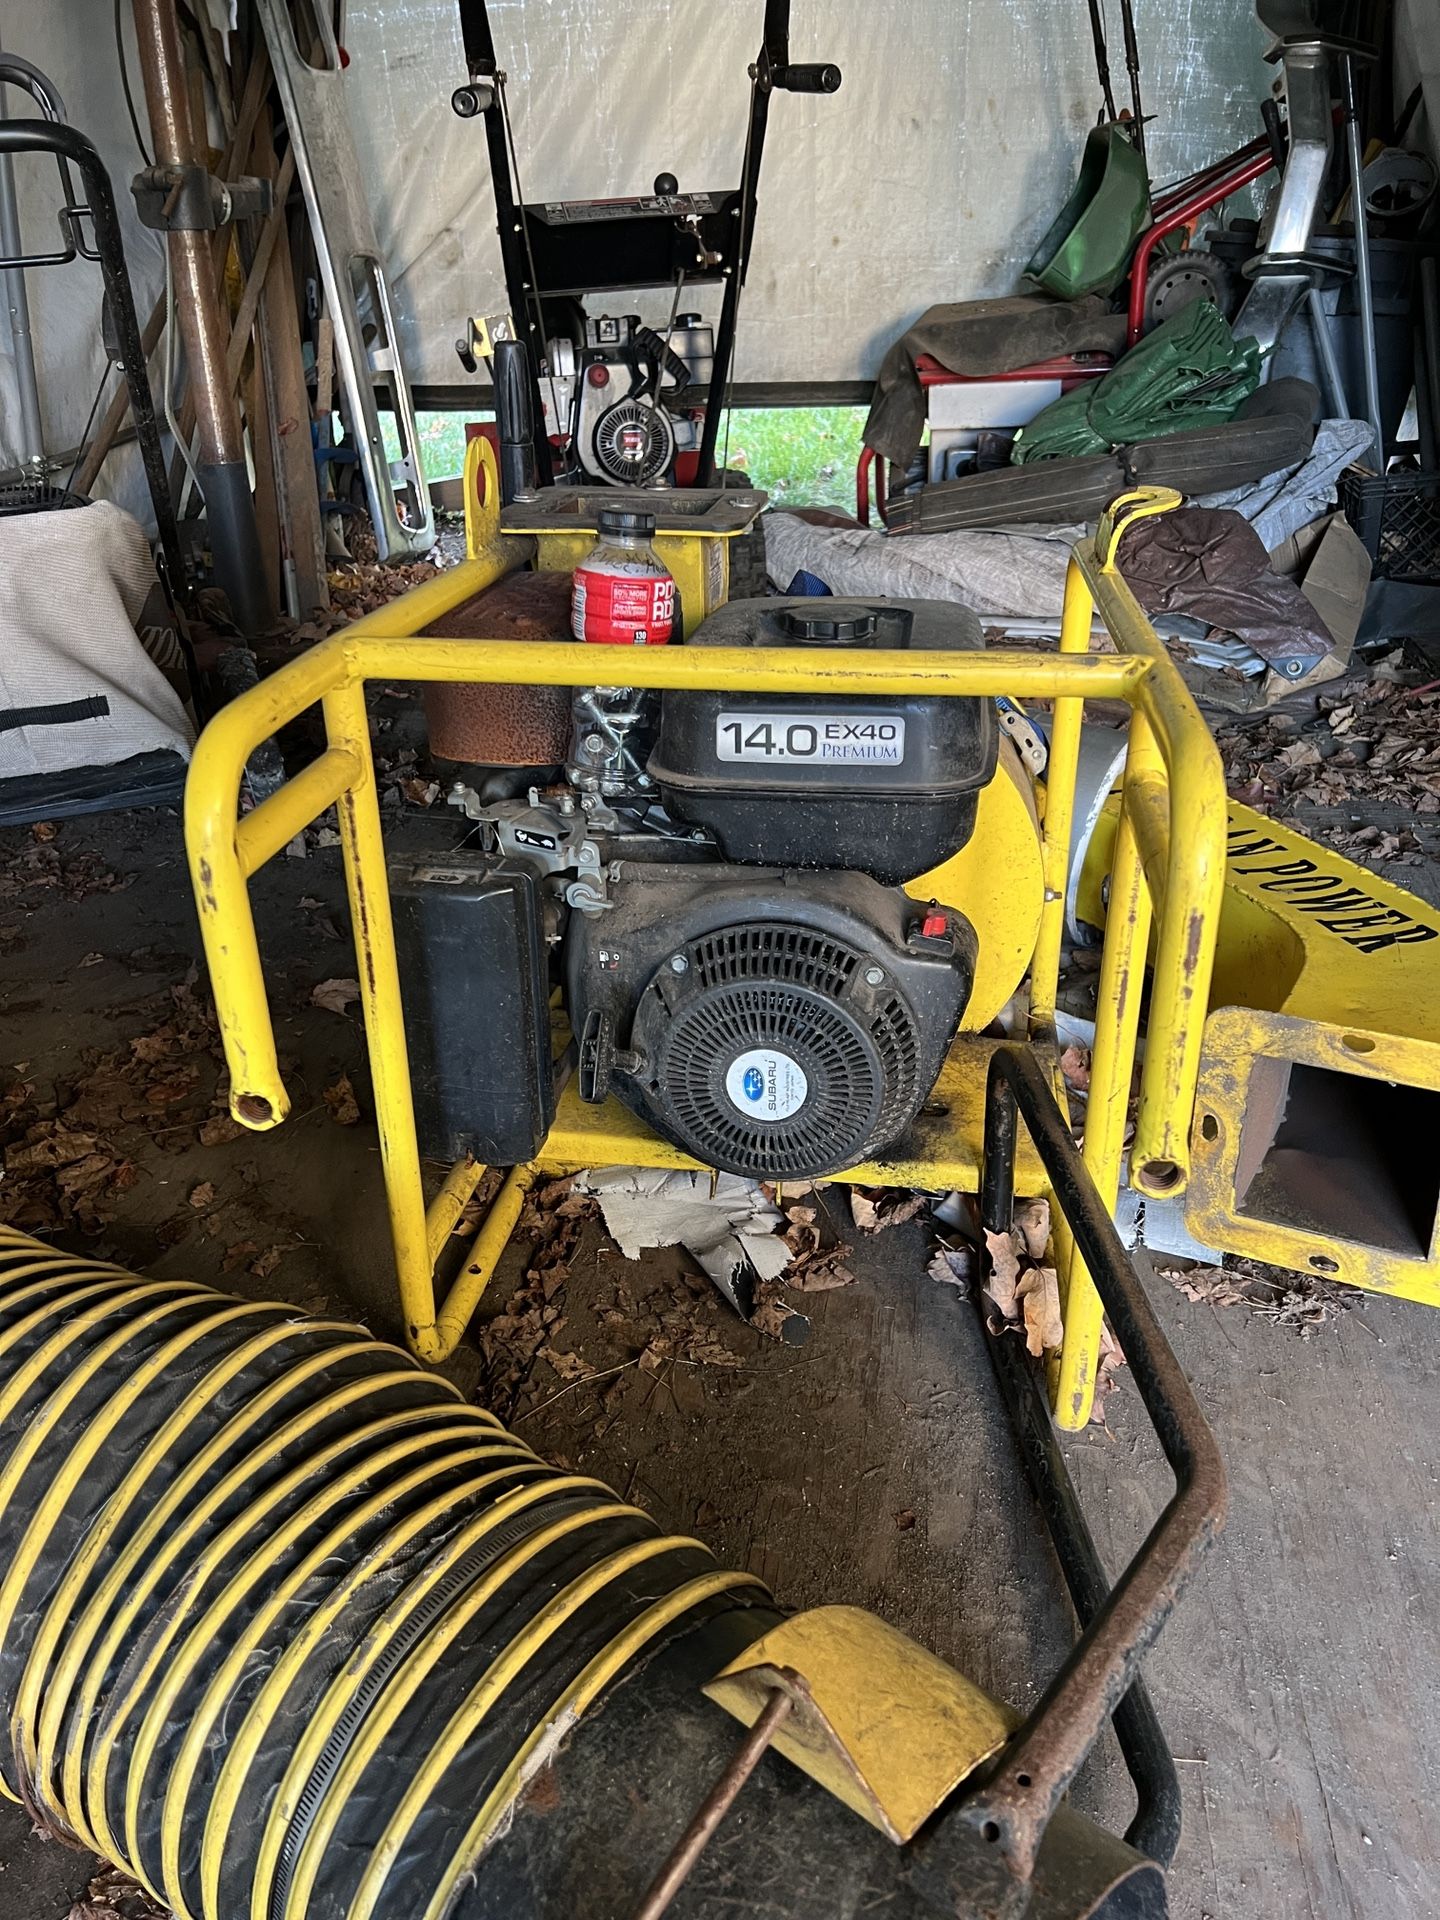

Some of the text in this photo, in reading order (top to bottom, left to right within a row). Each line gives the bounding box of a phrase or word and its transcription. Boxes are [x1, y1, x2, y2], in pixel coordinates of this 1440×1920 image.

[635, 631, 646, 640] 130
[722, 722, 896, 757] 14.0 EX40
[822, 743, 898, 759] PREMIUM
[1232, 859, 1439, 954] POWER
[768, 1060, 777, 1111] SUBARU
